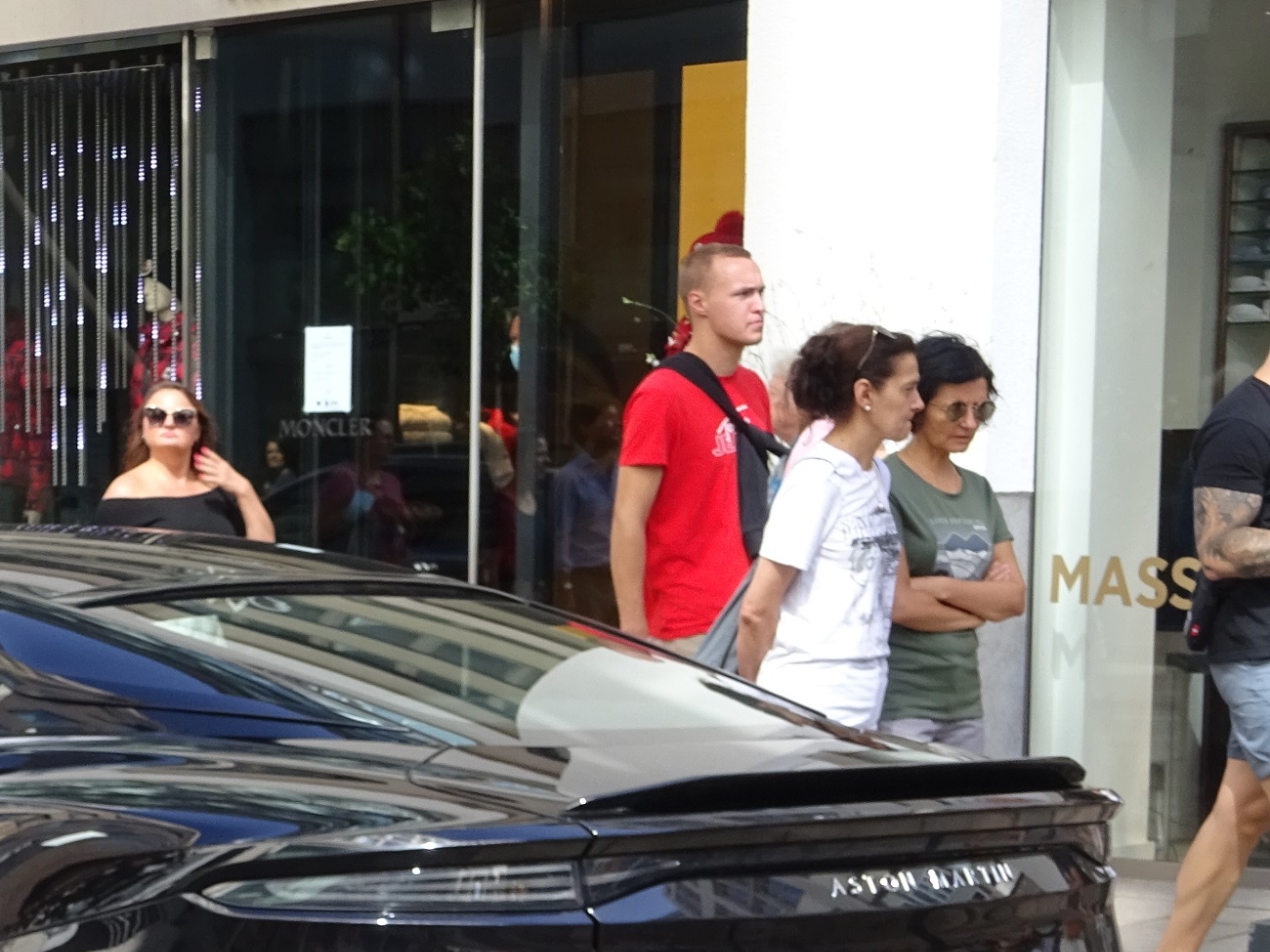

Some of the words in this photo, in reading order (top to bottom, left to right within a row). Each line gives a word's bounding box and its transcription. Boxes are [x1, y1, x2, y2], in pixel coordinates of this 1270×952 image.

[279, 418, 372, 438] MONCLER
[831, 870, 917, 898] ASTON
[928, 862, 1014, 890] MARTIN
